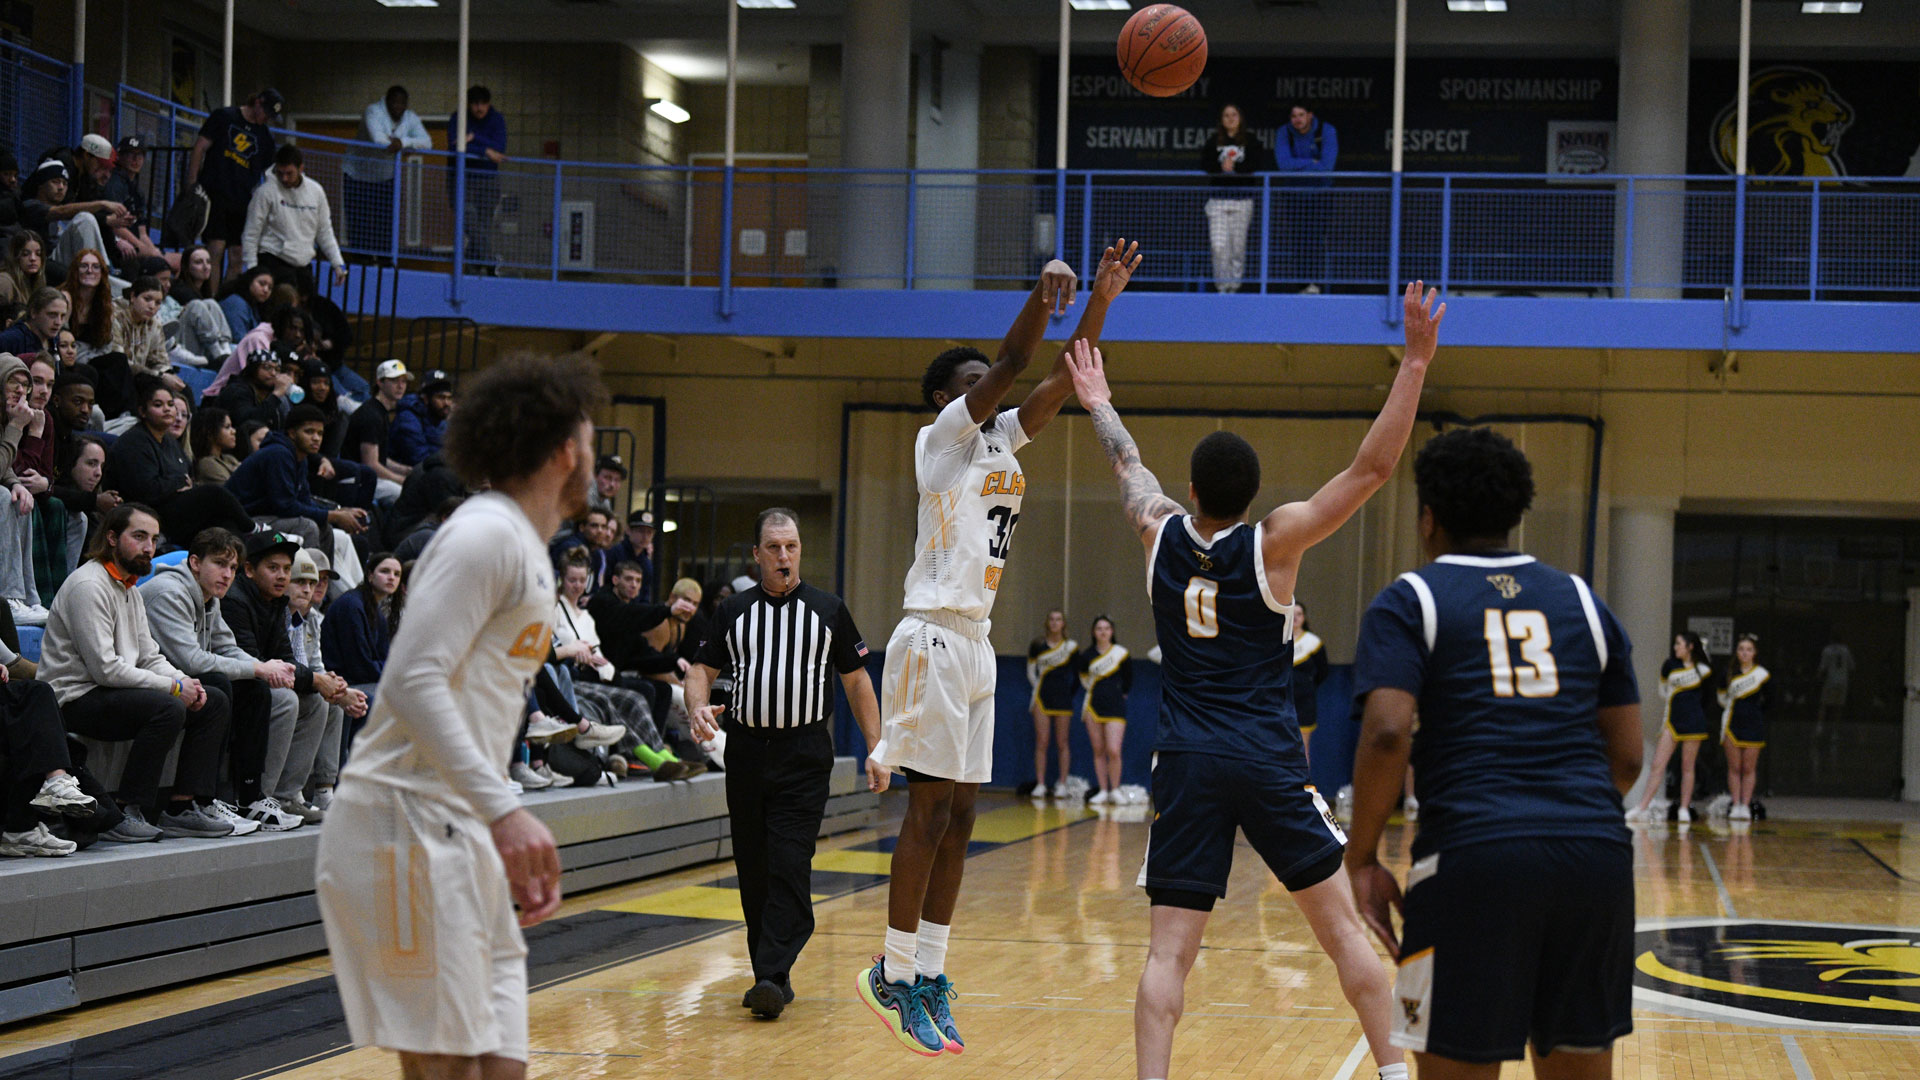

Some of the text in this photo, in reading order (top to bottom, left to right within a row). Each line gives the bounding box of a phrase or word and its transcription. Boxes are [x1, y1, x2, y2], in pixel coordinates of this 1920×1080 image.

[1276, 77, 1373, 99] INTEGRITY
[1439, 78, 1602, 101] SPORTSMANSHIP
[1086, 126, 1168, 149] SERVANT
[980, 470, 1026, 498] CLA
[1184, 576, 1219, 638] 0
[1484, 608, 1559, 698] 13
